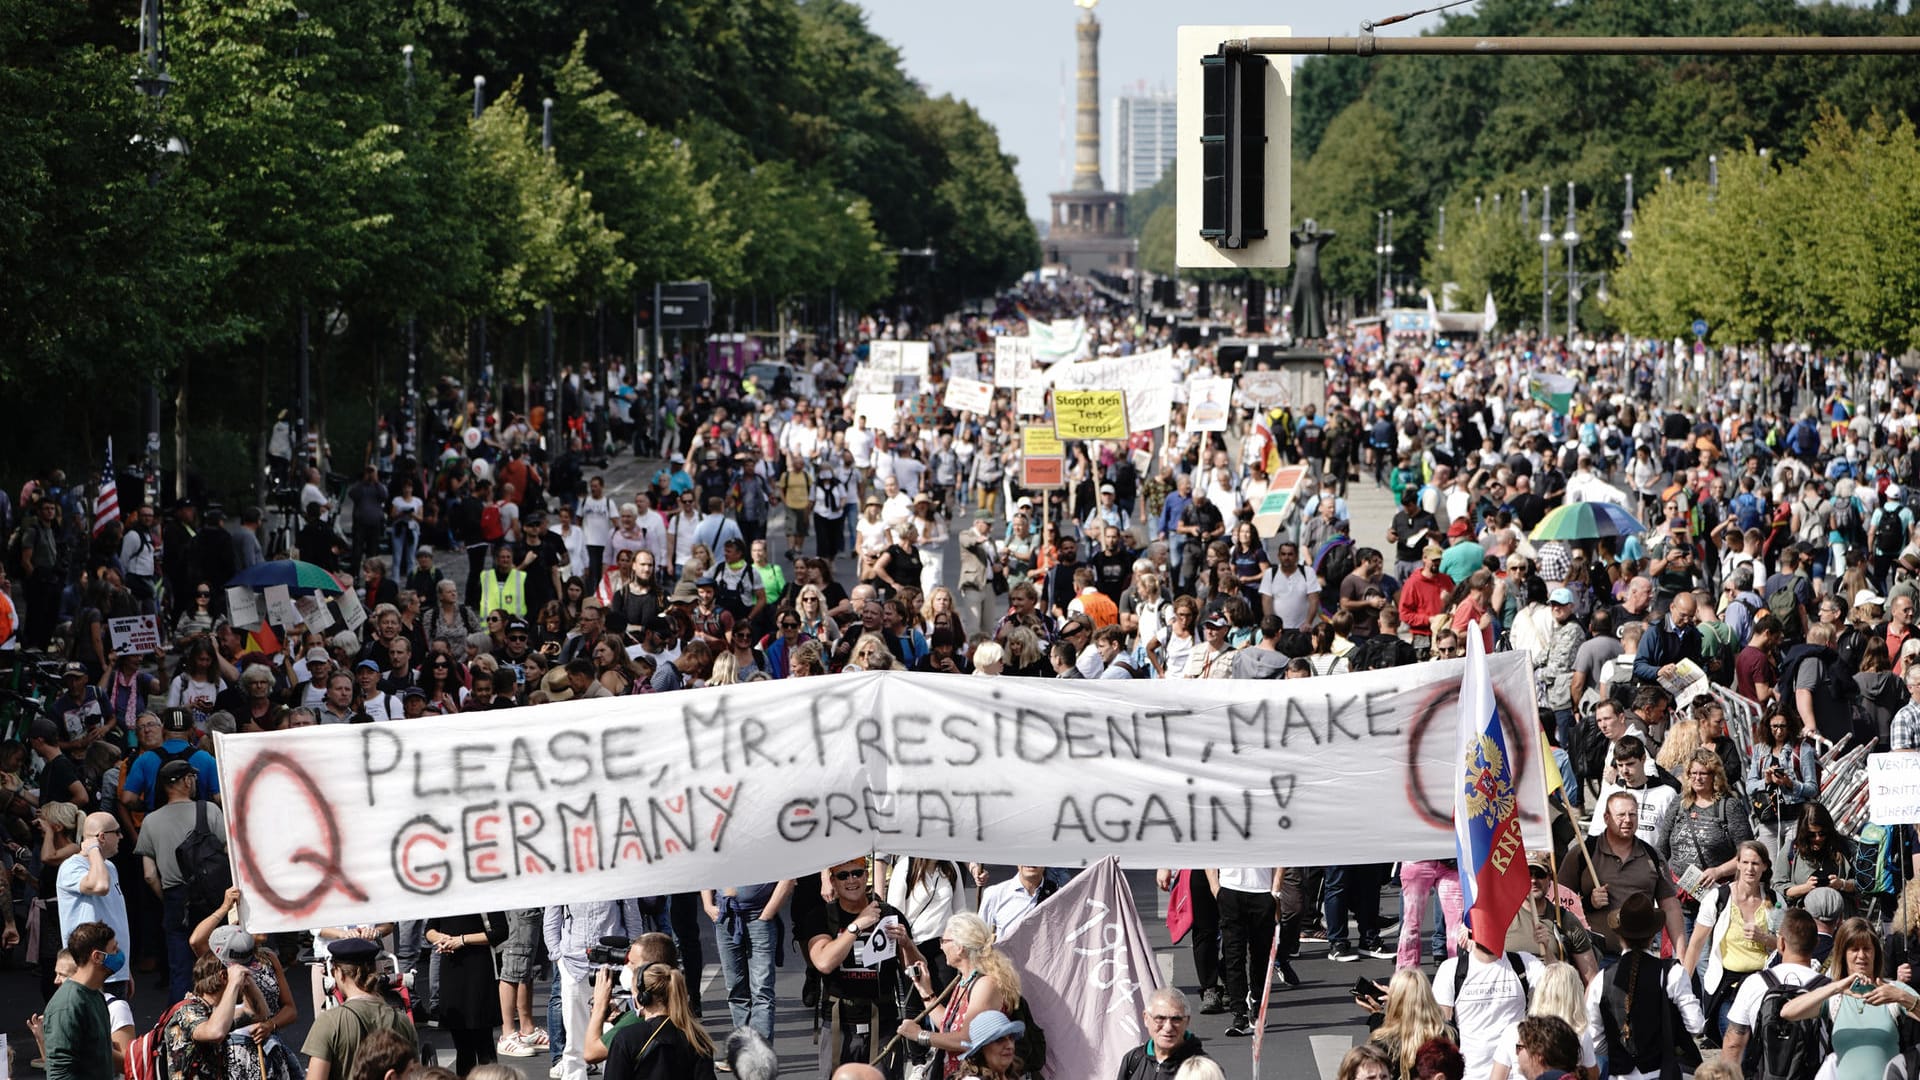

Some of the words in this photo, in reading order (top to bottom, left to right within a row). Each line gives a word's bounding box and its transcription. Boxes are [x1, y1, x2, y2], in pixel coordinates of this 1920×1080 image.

[1056, 395, 1094, 407] Stoppt
[1098, 395, 1120, 406] den
[1079, 410, 1108, 419] Test-
[361, 725, 670, 806] PLEASE,
[1227, 687, 1402, 755] MAKE
[231, 748, 370, 919] Q
[391, 781, 743, 896] GERMANY
[777, 786, 1013, 842] GREAT
[872, 928, 887, 953] Q
